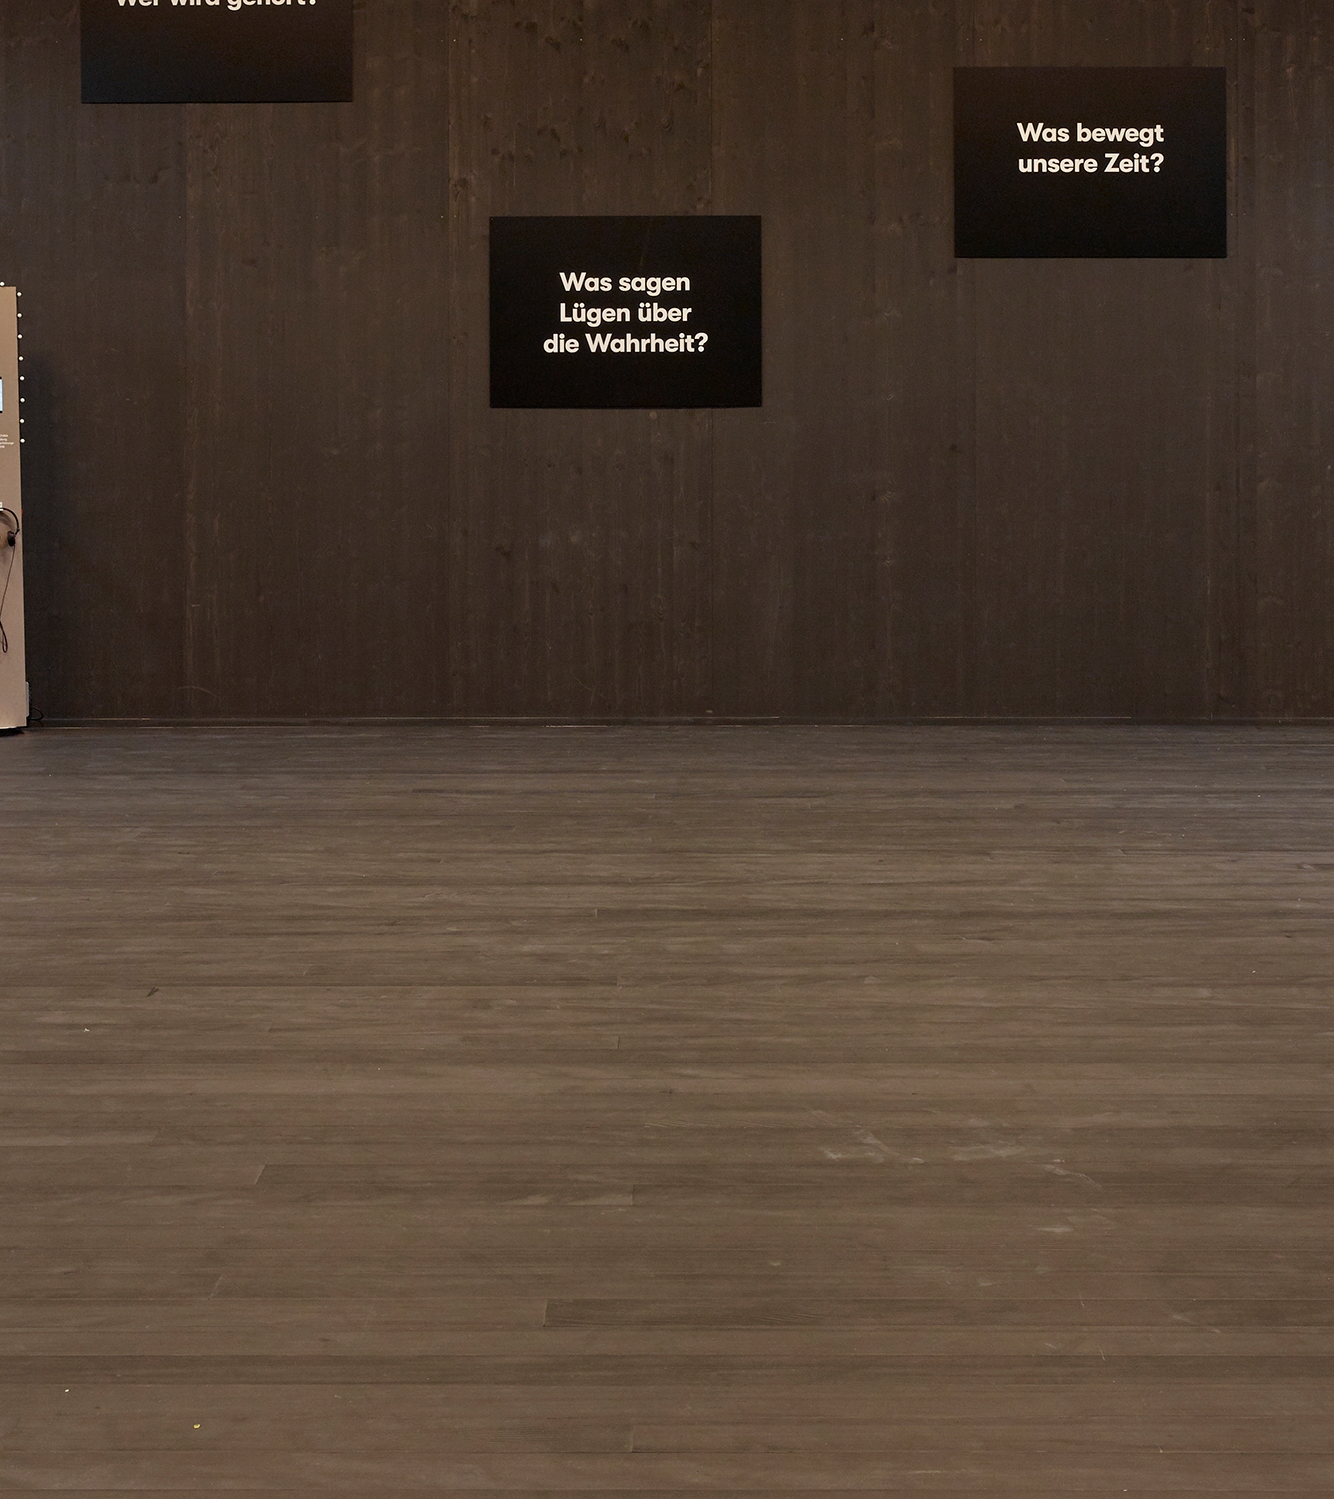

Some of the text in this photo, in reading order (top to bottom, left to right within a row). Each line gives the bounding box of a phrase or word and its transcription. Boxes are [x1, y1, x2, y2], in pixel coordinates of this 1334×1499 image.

[1017, 122, 1165, 148] Was bewegt
[1018, 152, 1165, 173] unsere Zeit?
[559, 271, 691, 297] Was sagen
[559, 302, 693, 328] Lügen über
[543, 332, 709, 353] die Wahrheit?
